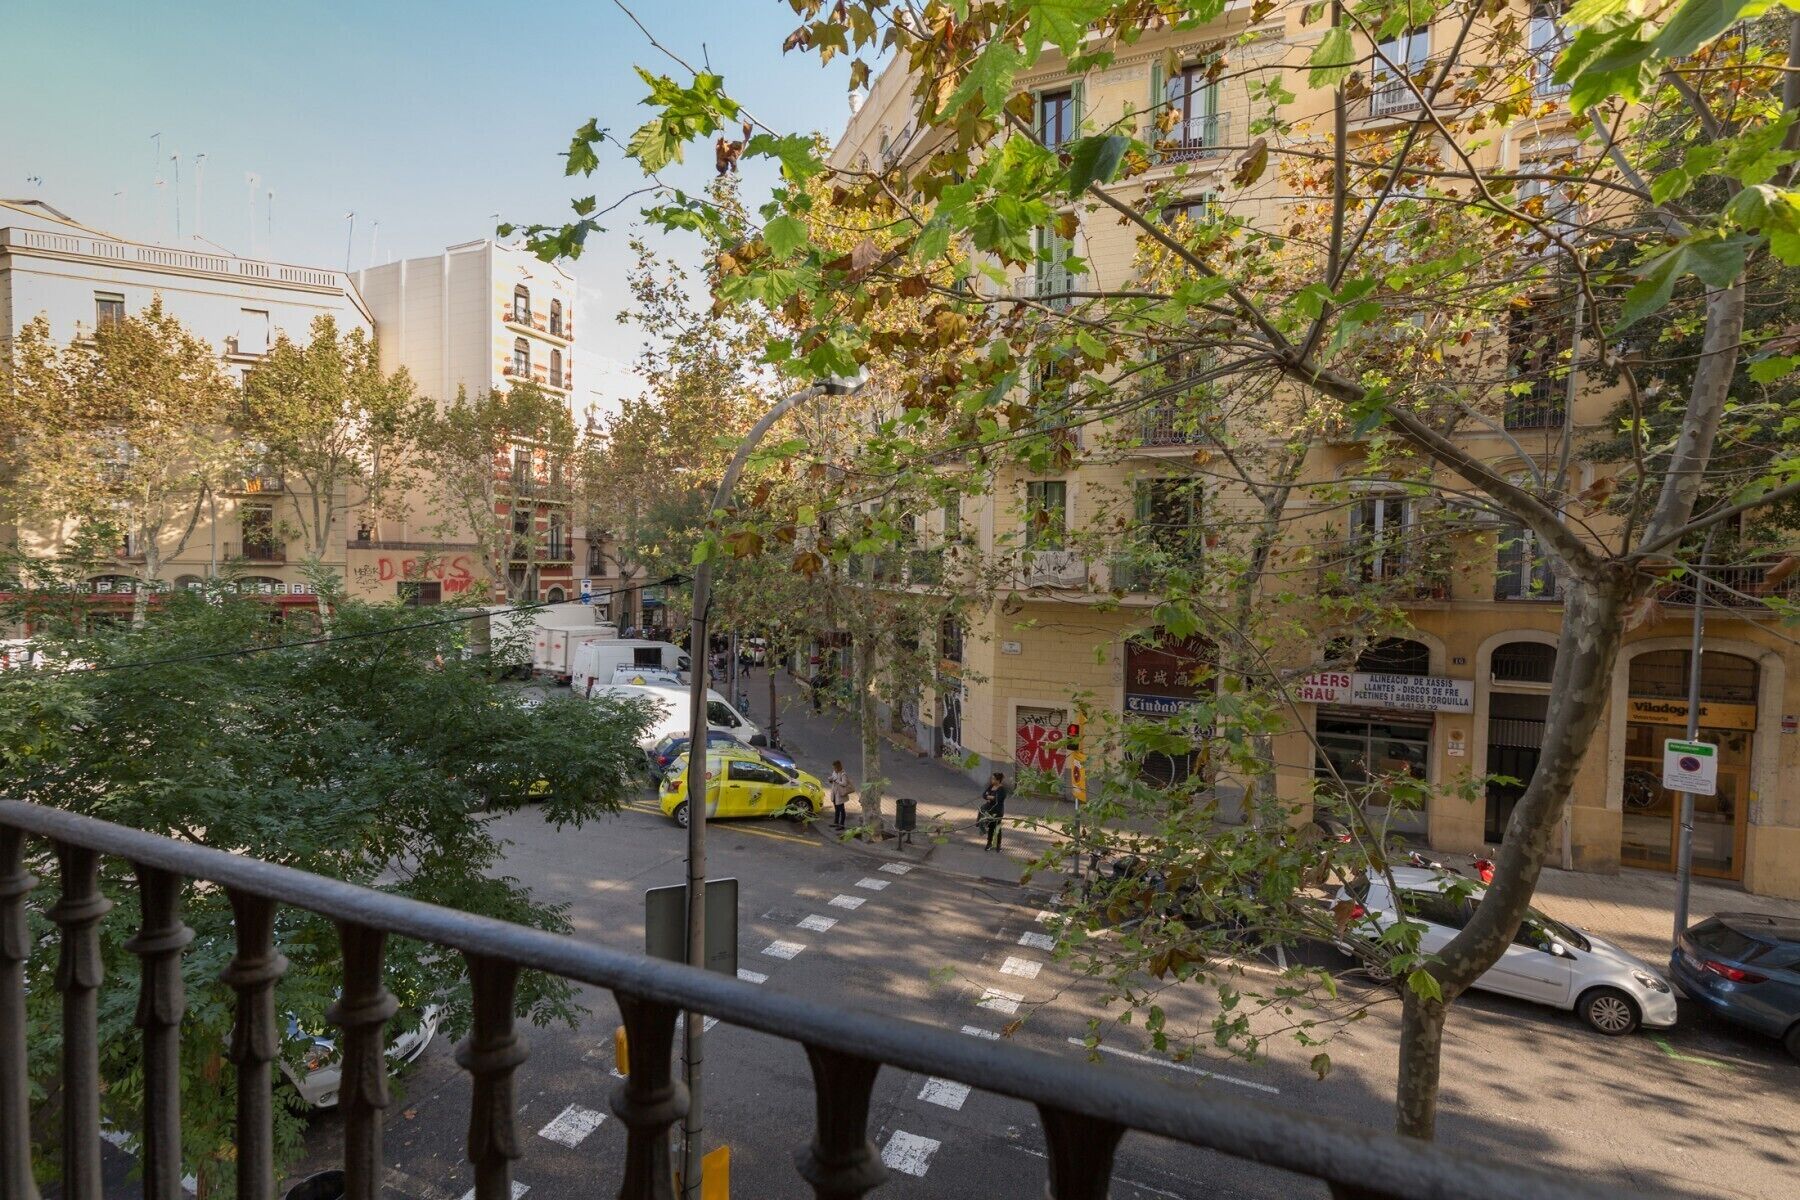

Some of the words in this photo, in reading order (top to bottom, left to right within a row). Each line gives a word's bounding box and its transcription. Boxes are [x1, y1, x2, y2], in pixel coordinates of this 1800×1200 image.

[1136, 668, 1206, 688] 花城酒
[1413, 677, 1424, 686] DE
[1425, 678, 1453, 688] XASSIS
[1364, 680, 1395, 692] LLANTES
[1402, 685, 1430, 696] DISCOS
[1432, 686, 1443, 697] DE
[1354, 690, 1388, 701] PLETINES
[1395, 693, 1424, 704] BARRES
[1427, 695, 1469, 707] FORQUILLA
